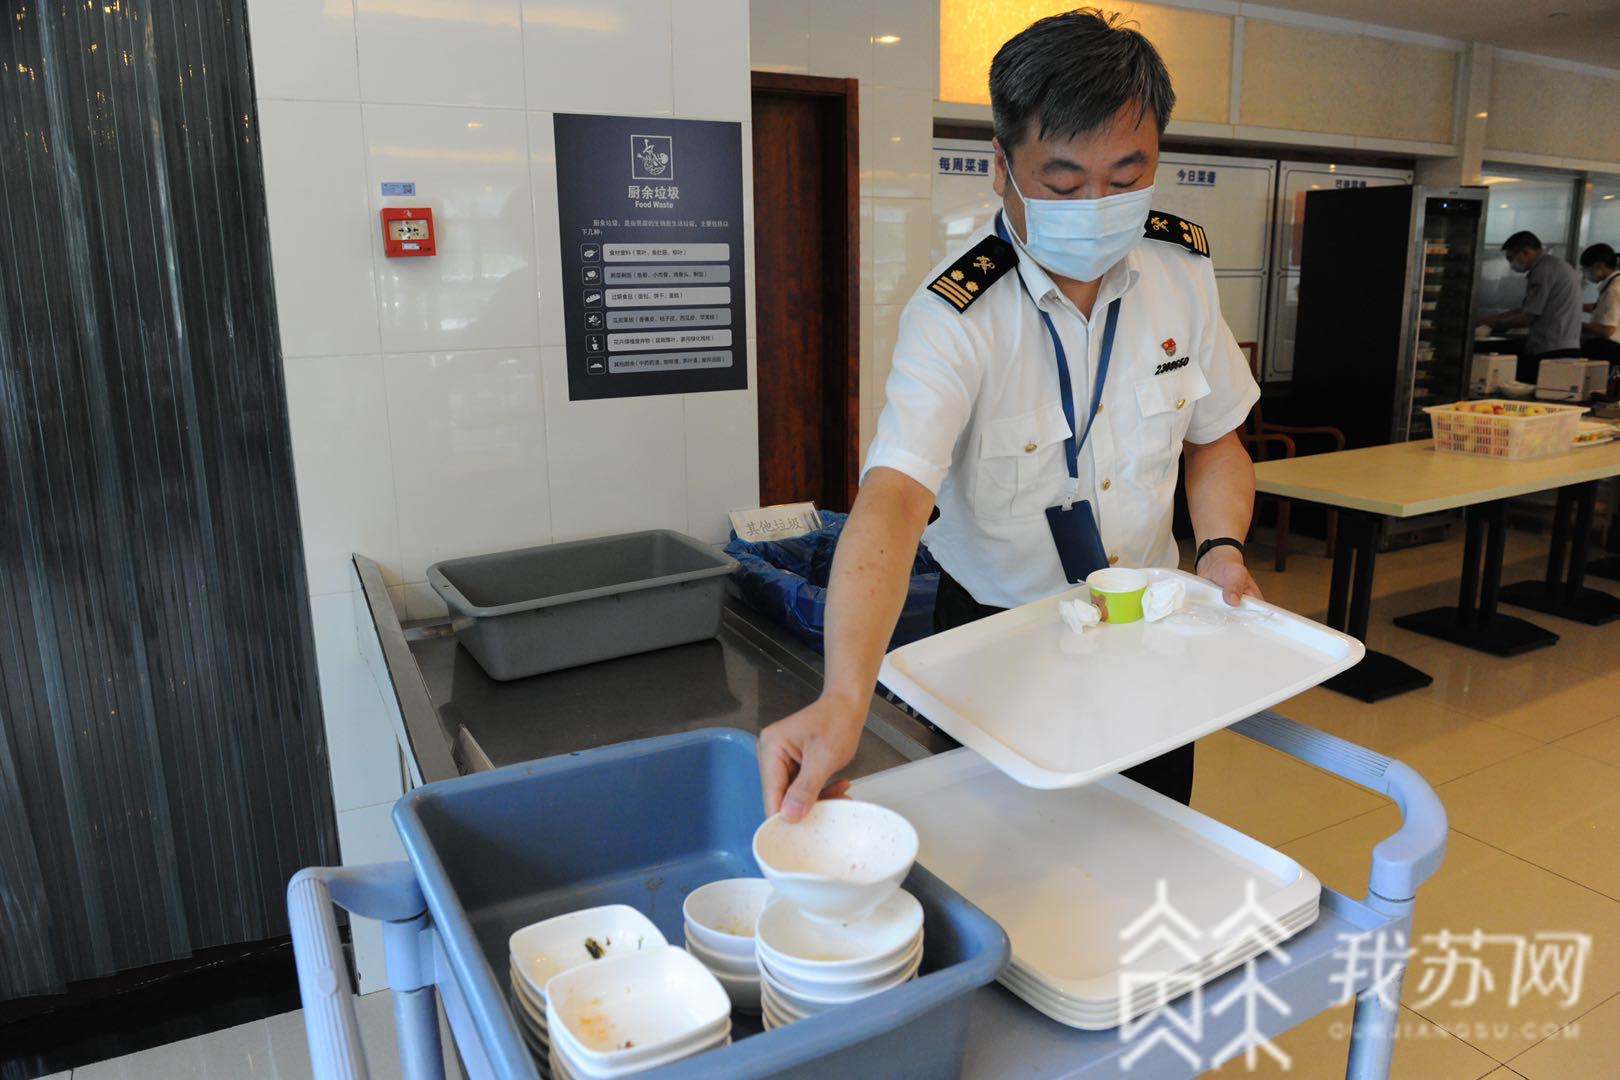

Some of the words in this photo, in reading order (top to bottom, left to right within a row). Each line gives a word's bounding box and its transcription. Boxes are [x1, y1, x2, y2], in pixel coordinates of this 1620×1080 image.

[628, 185, 680, 200] 厨余垃圾
[635, 200, 652, 209] Food
[653, 200, 674, 209] Waste
